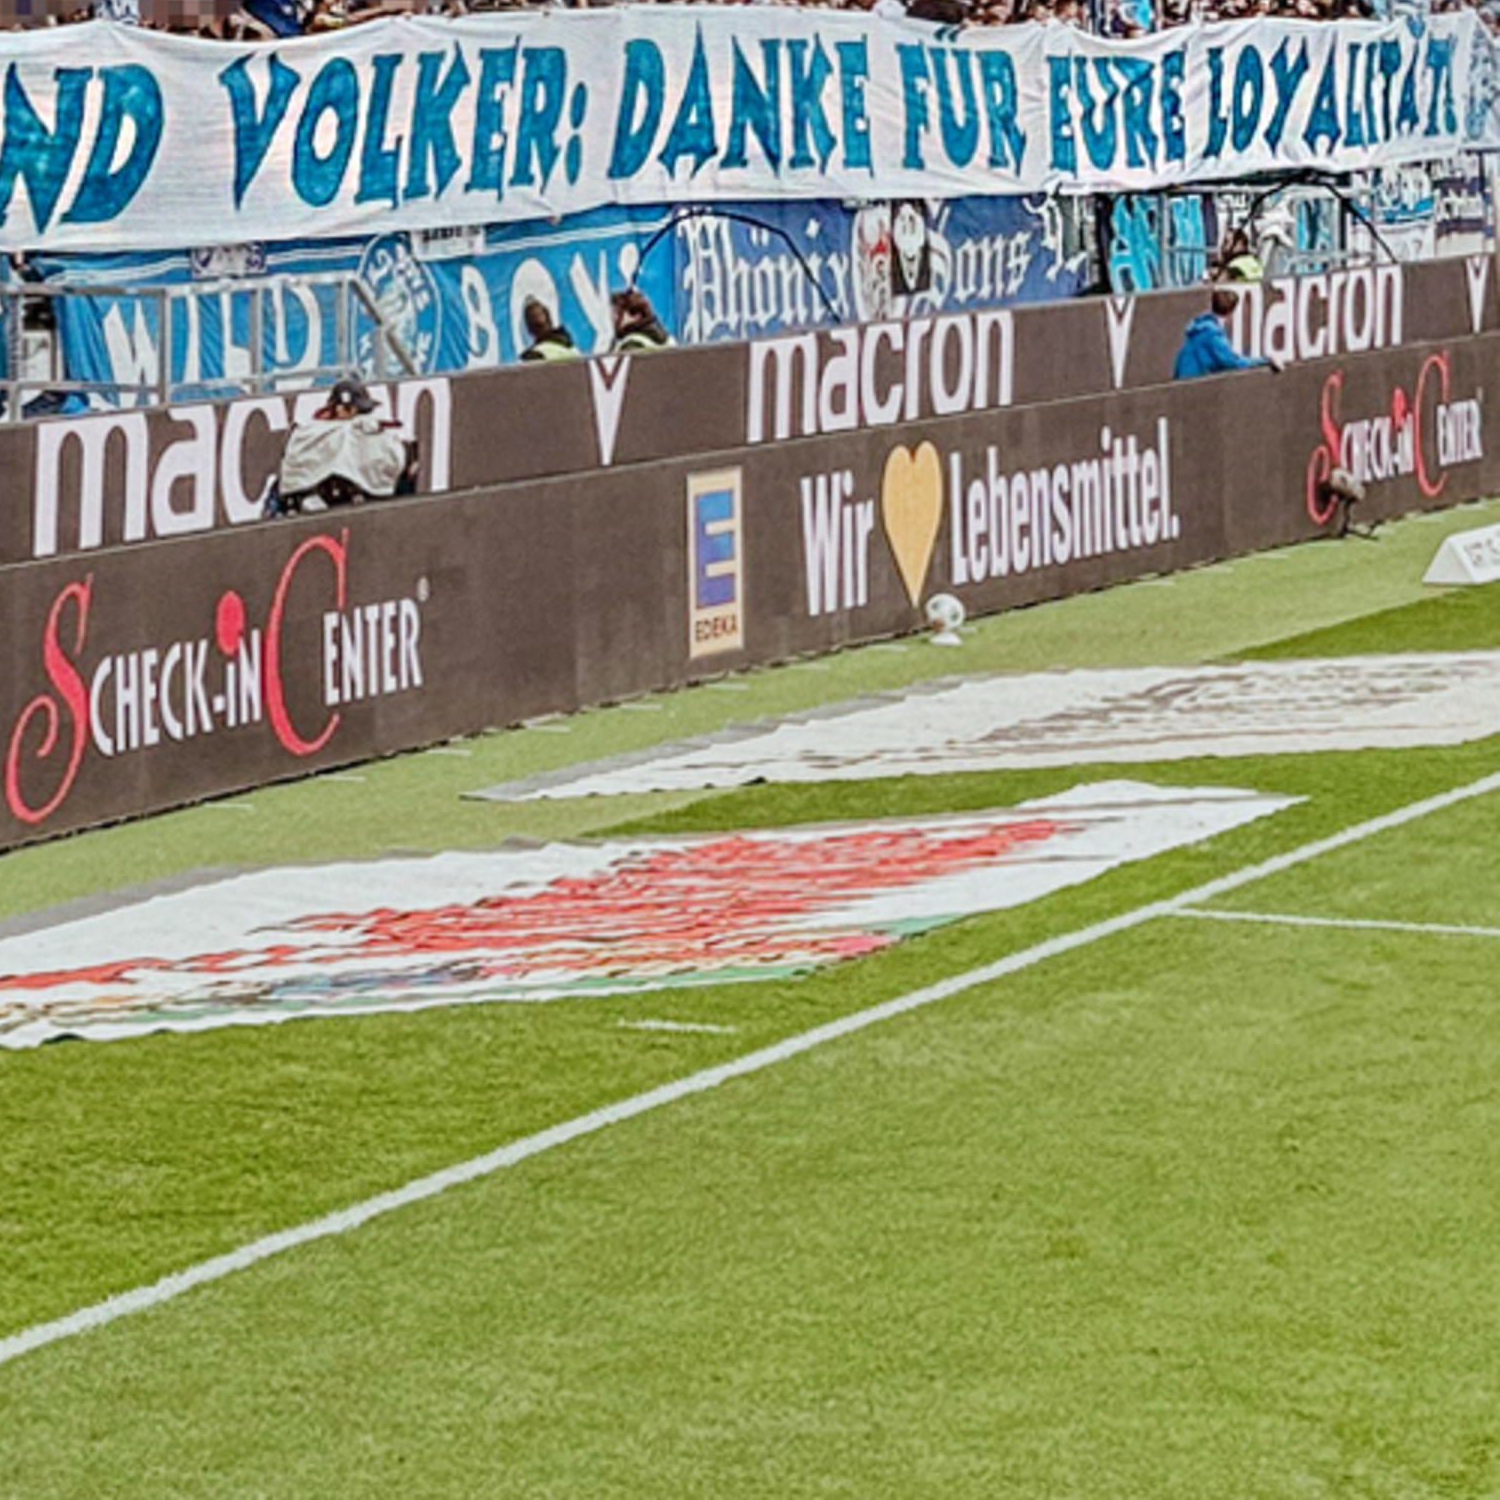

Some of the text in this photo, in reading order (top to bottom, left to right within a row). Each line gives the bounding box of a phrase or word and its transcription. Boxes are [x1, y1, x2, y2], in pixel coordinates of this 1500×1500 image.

[218, 35, 588, 211] VOLKER:
[607, 18, 875, 180] DANKE
[895, 24, 1028, 178] FÜR
[1046, 42, 1188, 176] EURE
[102, 284, 322, 408] WILD
[746, 310, 1014, 444] macron
[800, 415, 1181, 616] Wir Lebensmittel.
[694, 613, 739, 643] EDEKA
